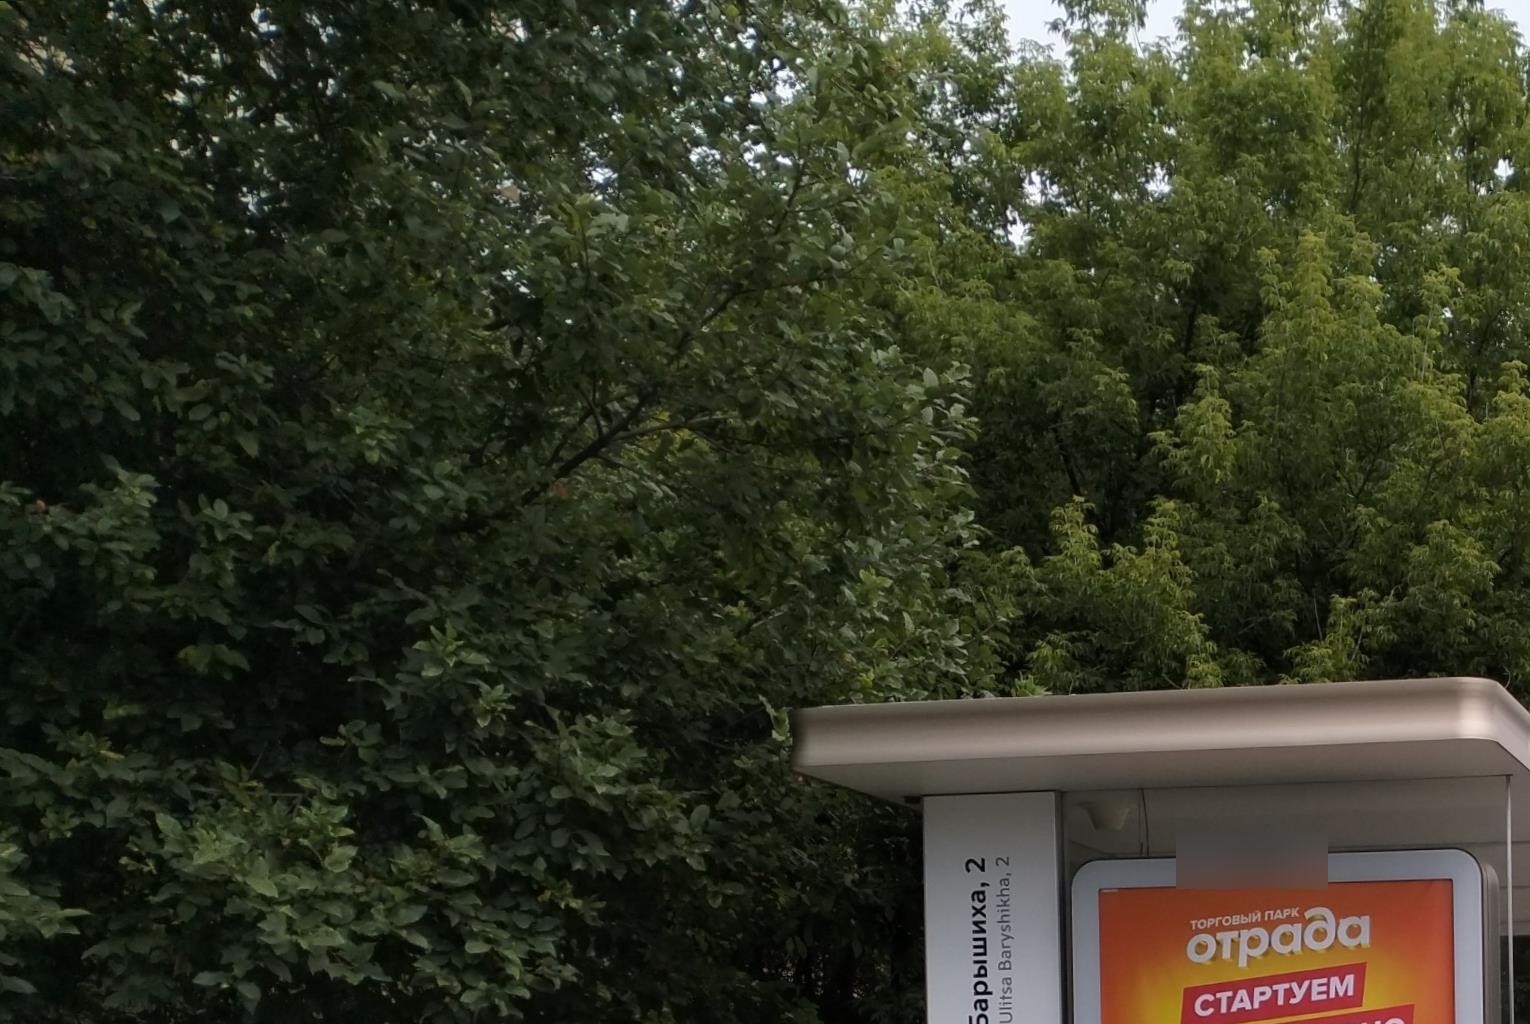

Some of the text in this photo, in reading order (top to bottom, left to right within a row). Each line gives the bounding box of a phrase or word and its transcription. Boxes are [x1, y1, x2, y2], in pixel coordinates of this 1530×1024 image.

[965, 857, 986, 873] 2
[1186, 906, 1371, 968] отрада
[1190, 906, 1300, 930] ТОРГОВЫЙ ПАРК
[995, 856, 1015, 1024] Ulitsa Baryshikha, 2
[1194, 974, 1355, 1017] СТАРТУЕМ
